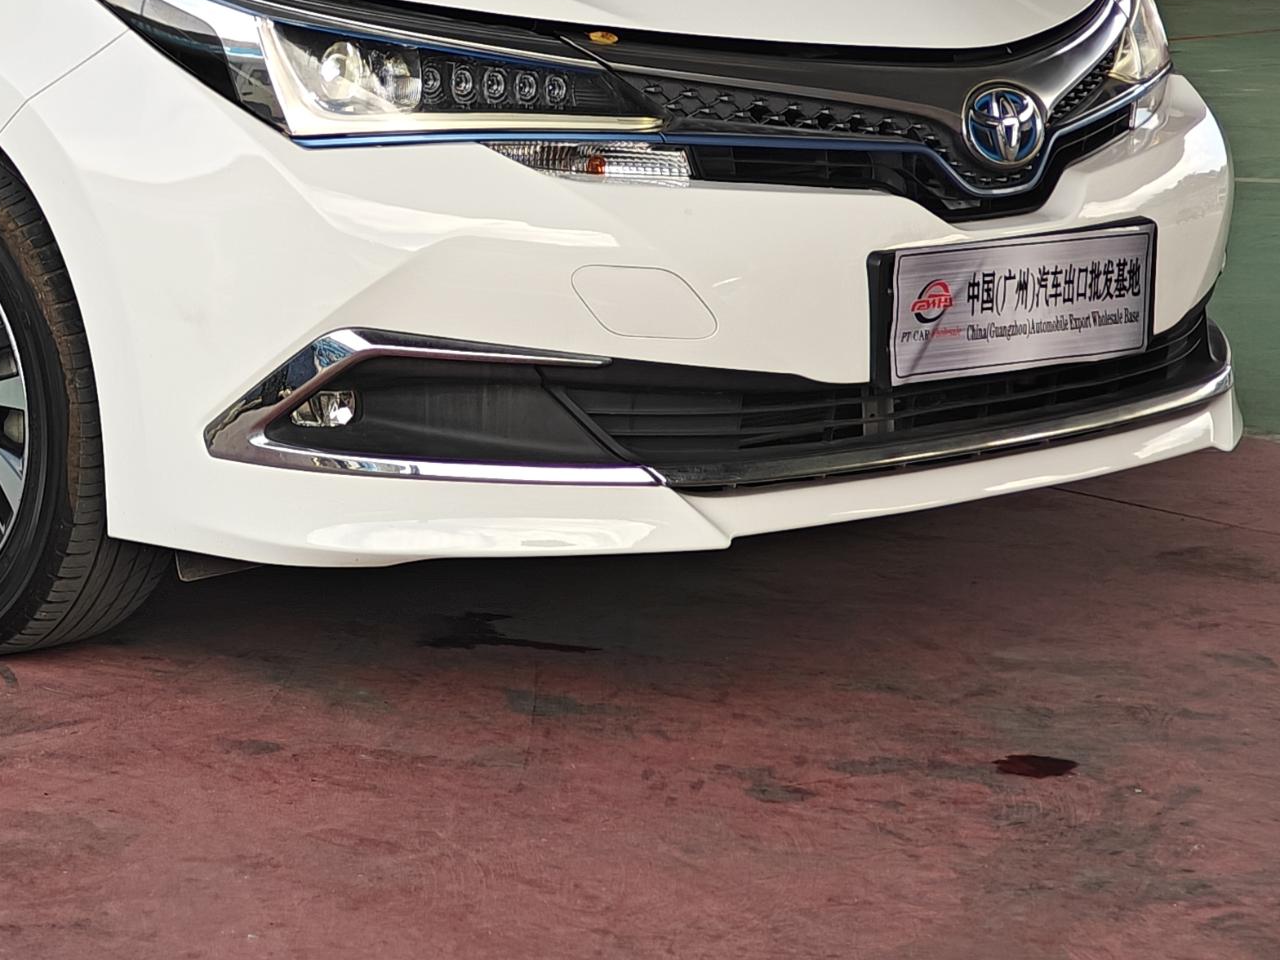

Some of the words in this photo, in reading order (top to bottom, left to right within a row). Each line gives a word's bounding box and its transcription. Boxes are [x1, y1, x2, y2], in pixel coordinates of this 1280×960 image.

[1069, 313, 1091, 332] Export
[1092, 310, 1123, 327] Wholesale
[1124, 307, 1139, 324] Base
[901, 331, 911, 343] PT
